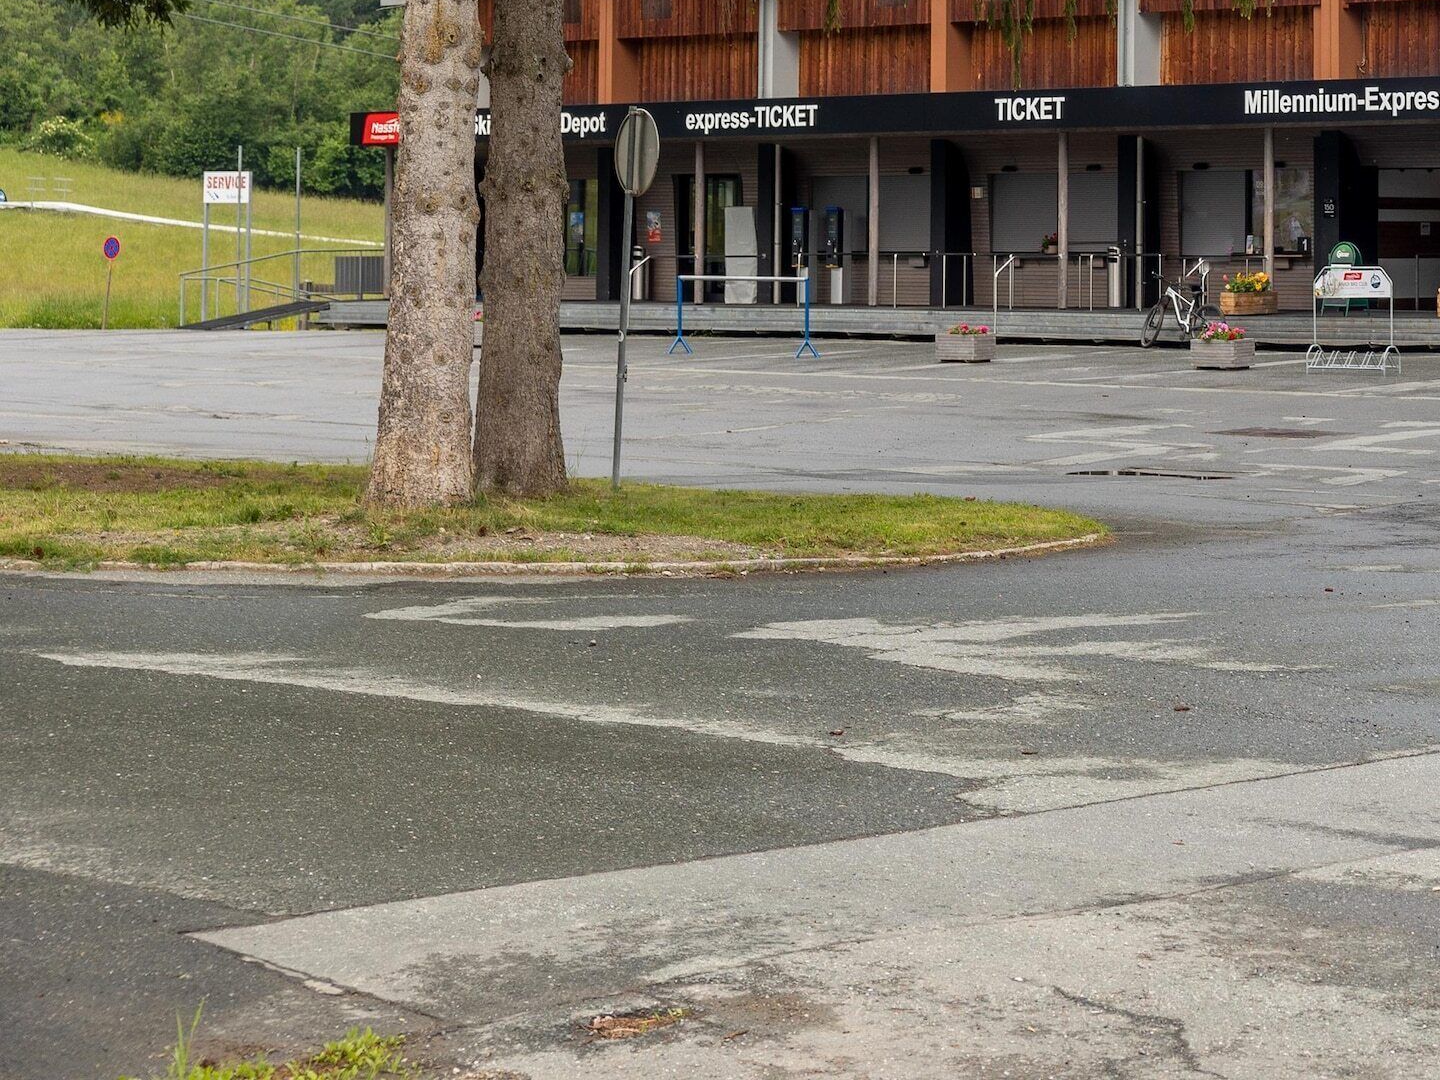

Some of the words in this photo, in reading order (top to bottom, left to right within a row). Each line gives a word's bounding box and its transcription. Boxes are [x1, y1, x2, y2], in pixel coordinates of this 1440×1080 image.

[685, 104, 818, 134] express-TICKET
[994, 96, 1066, 121] TICKET
[560, 111, 606, 138] Depot
[207, 176, 246, 189] SERVICE
[1302, 238, 1307, 251] 1
